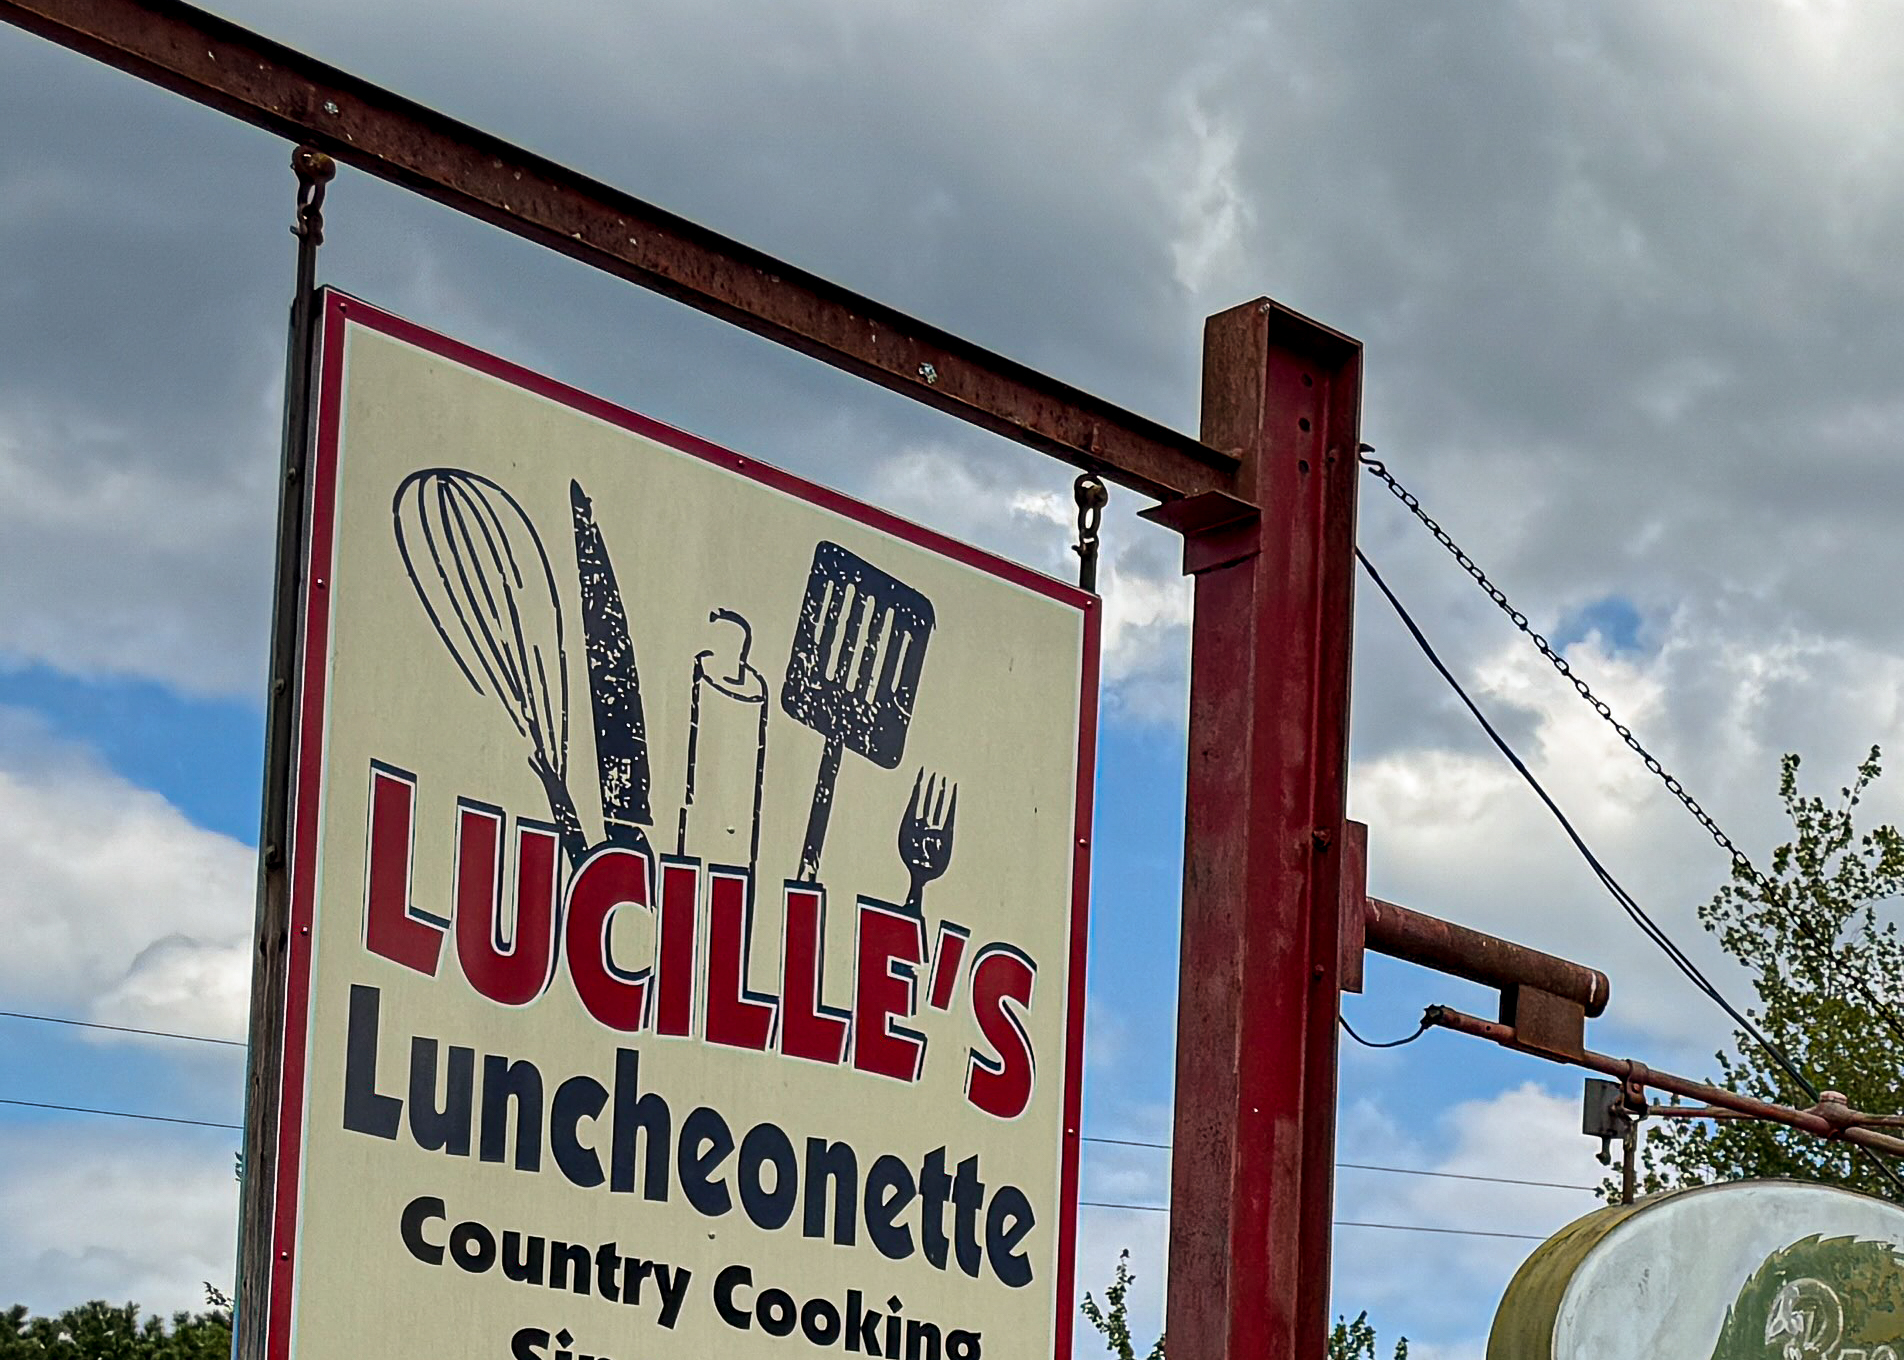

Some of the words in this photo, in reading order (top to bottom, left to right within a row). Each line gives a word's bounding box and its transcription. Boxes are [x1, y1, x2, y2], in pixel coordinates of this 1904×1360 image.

[364, 758, 1037, 1119] LUCILLE'S
[342, 985, 1035, 1289] Luncheonette
[400, 1196, 693, 1330] Country
